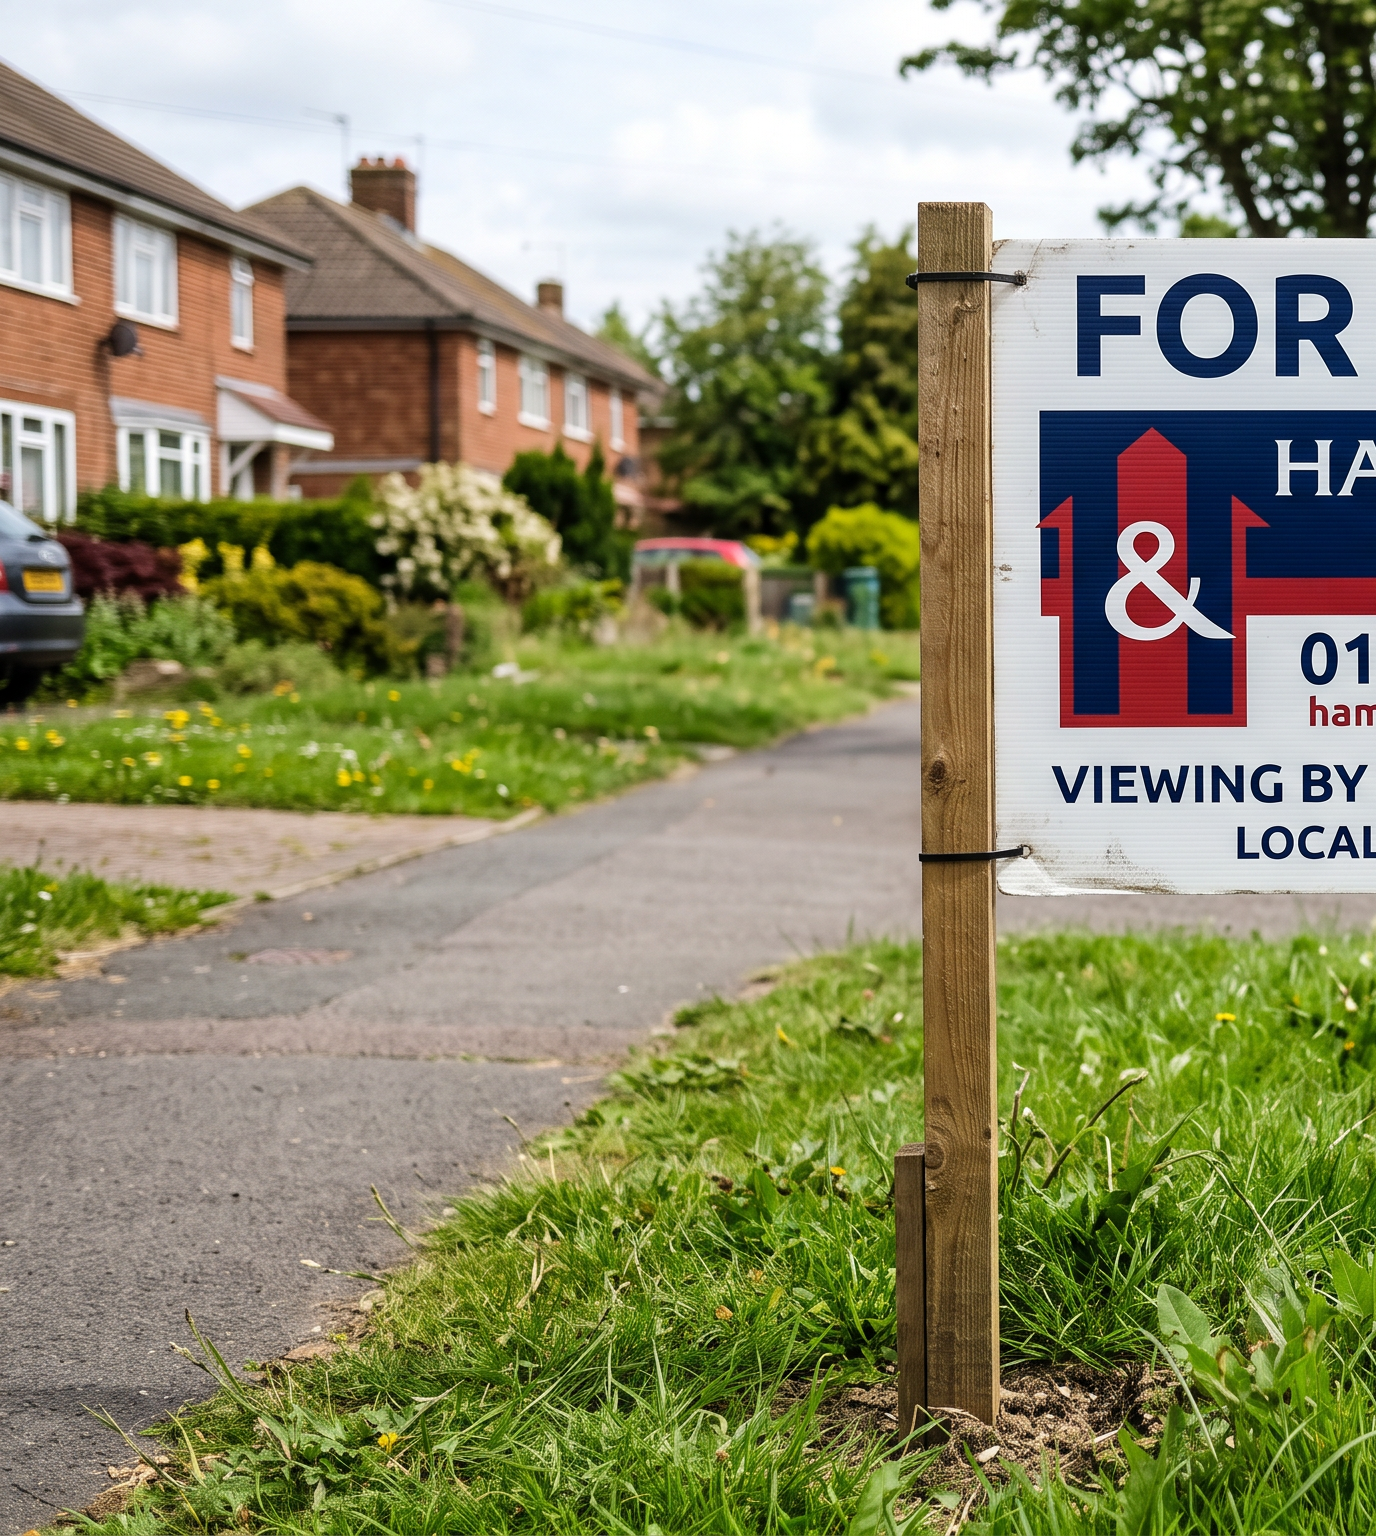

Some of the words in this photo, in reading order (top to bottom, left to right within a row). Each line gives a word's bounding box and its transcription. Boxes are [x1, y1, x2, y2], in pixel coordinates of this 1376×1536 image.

[1077, 274, 1358, 378] FOR
[1105, 521, 1236, 640] &
[1052, 764, 1282, 803] VIEWING
[1303, 764, 1368, 802] BY
